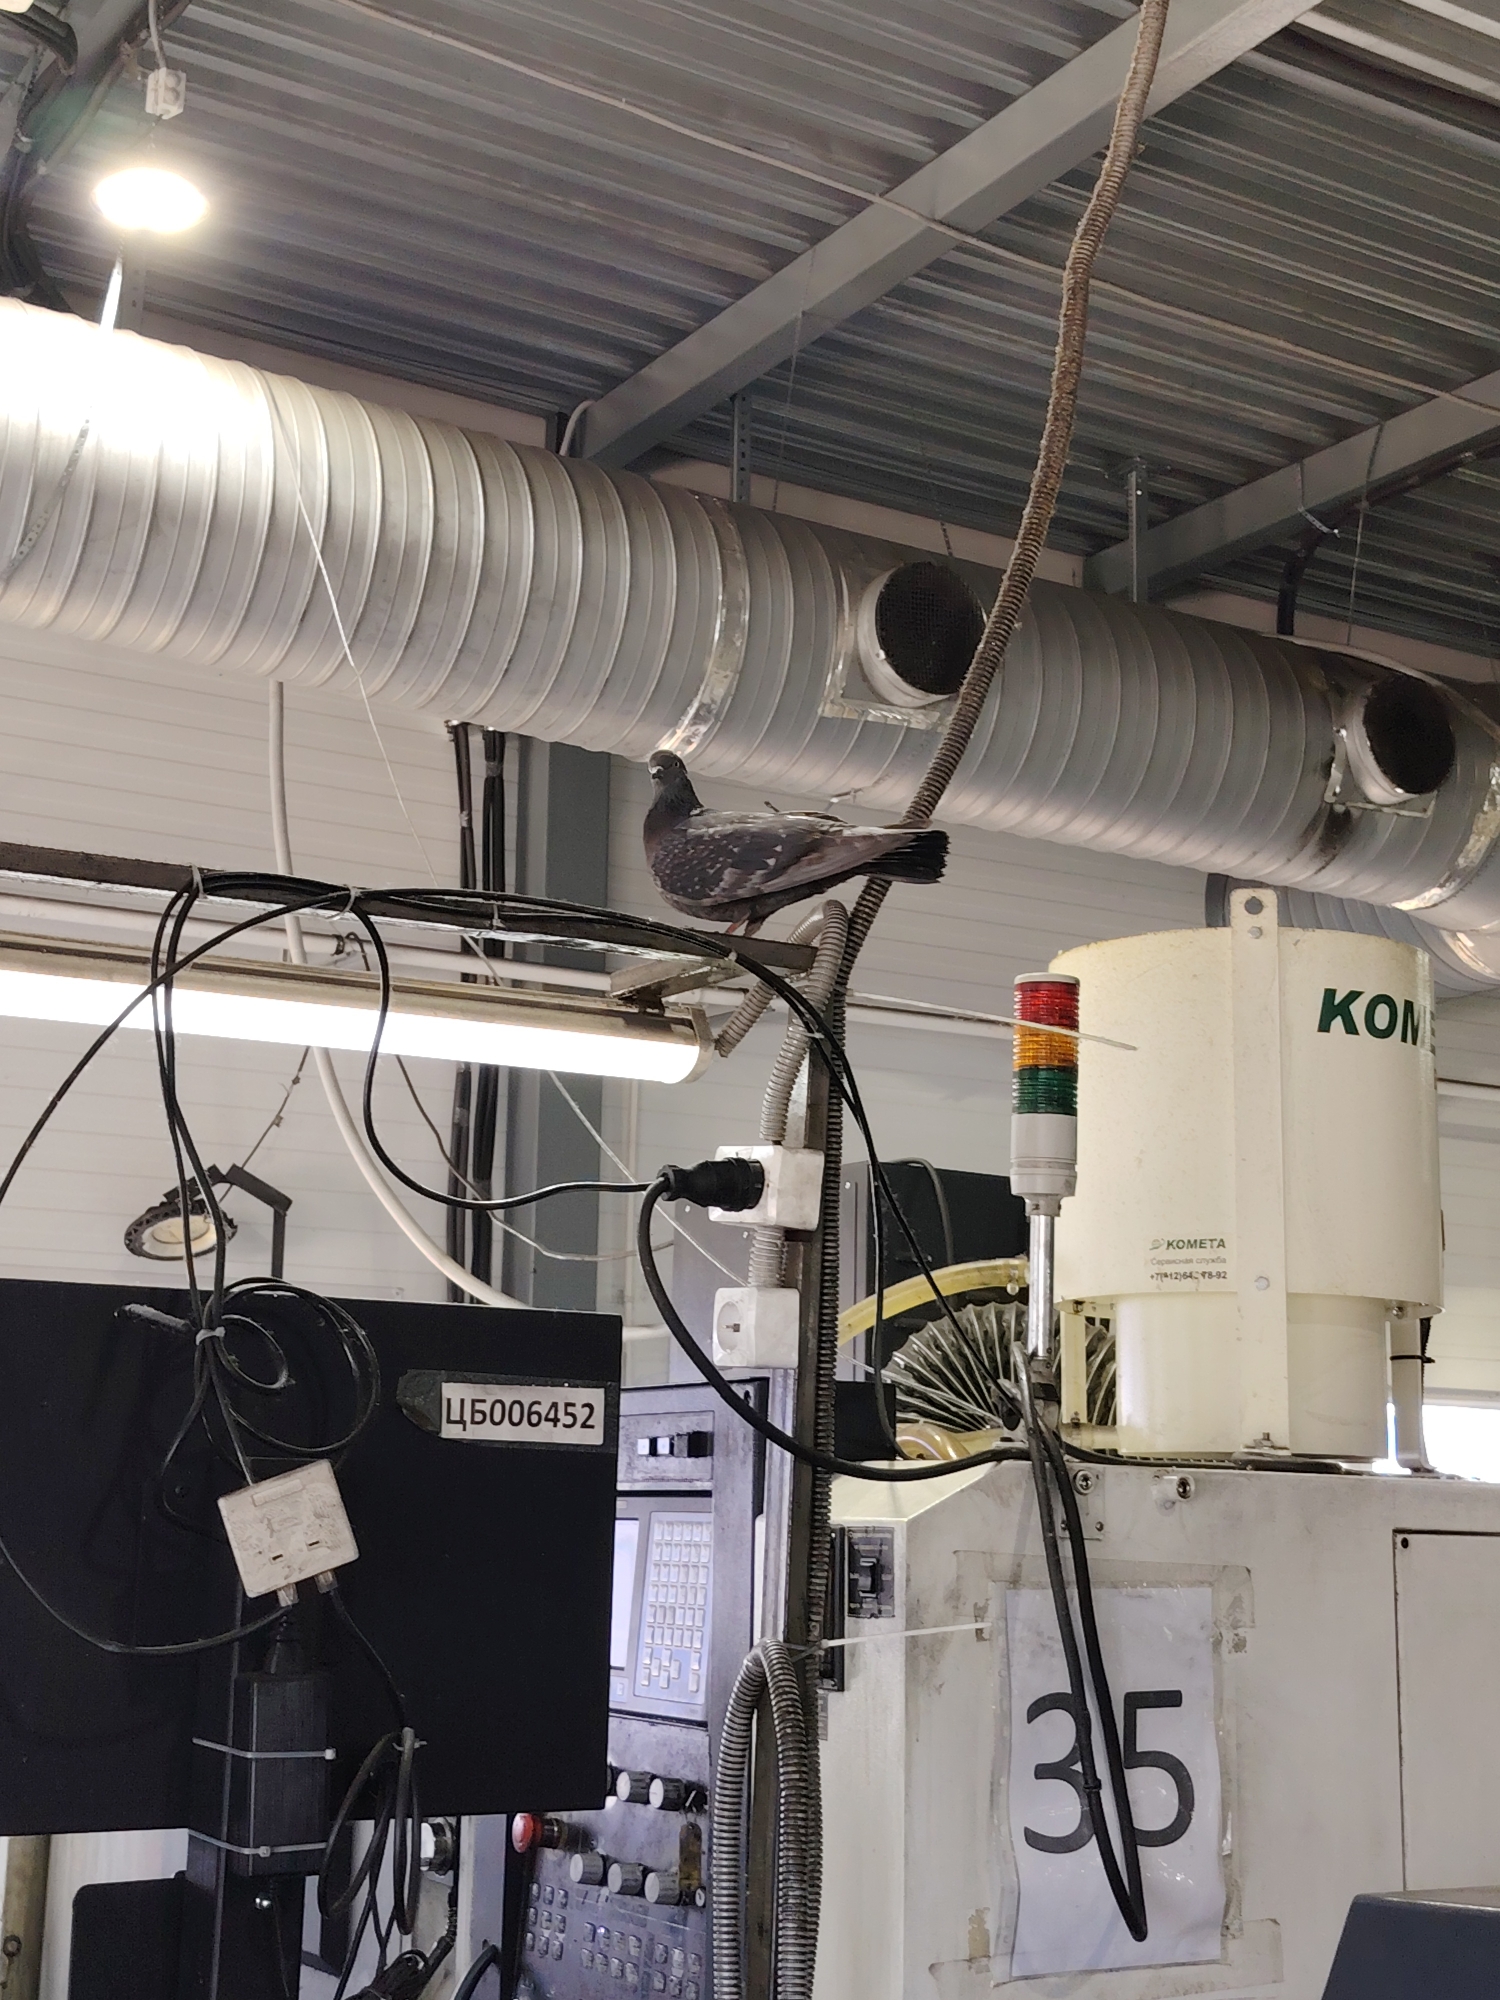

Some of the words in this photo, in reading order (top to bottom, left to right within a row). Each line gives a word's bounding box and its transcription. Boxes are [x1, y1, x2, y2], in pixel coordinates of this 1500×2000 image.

[1150, 1257, 1194, 1266] Сервисная
[1195, 1255, 1227, 1266] служба
[446, 1397, 596, 1432] ЦБ006452
[1024, 1689, 1195, 1854] 35
